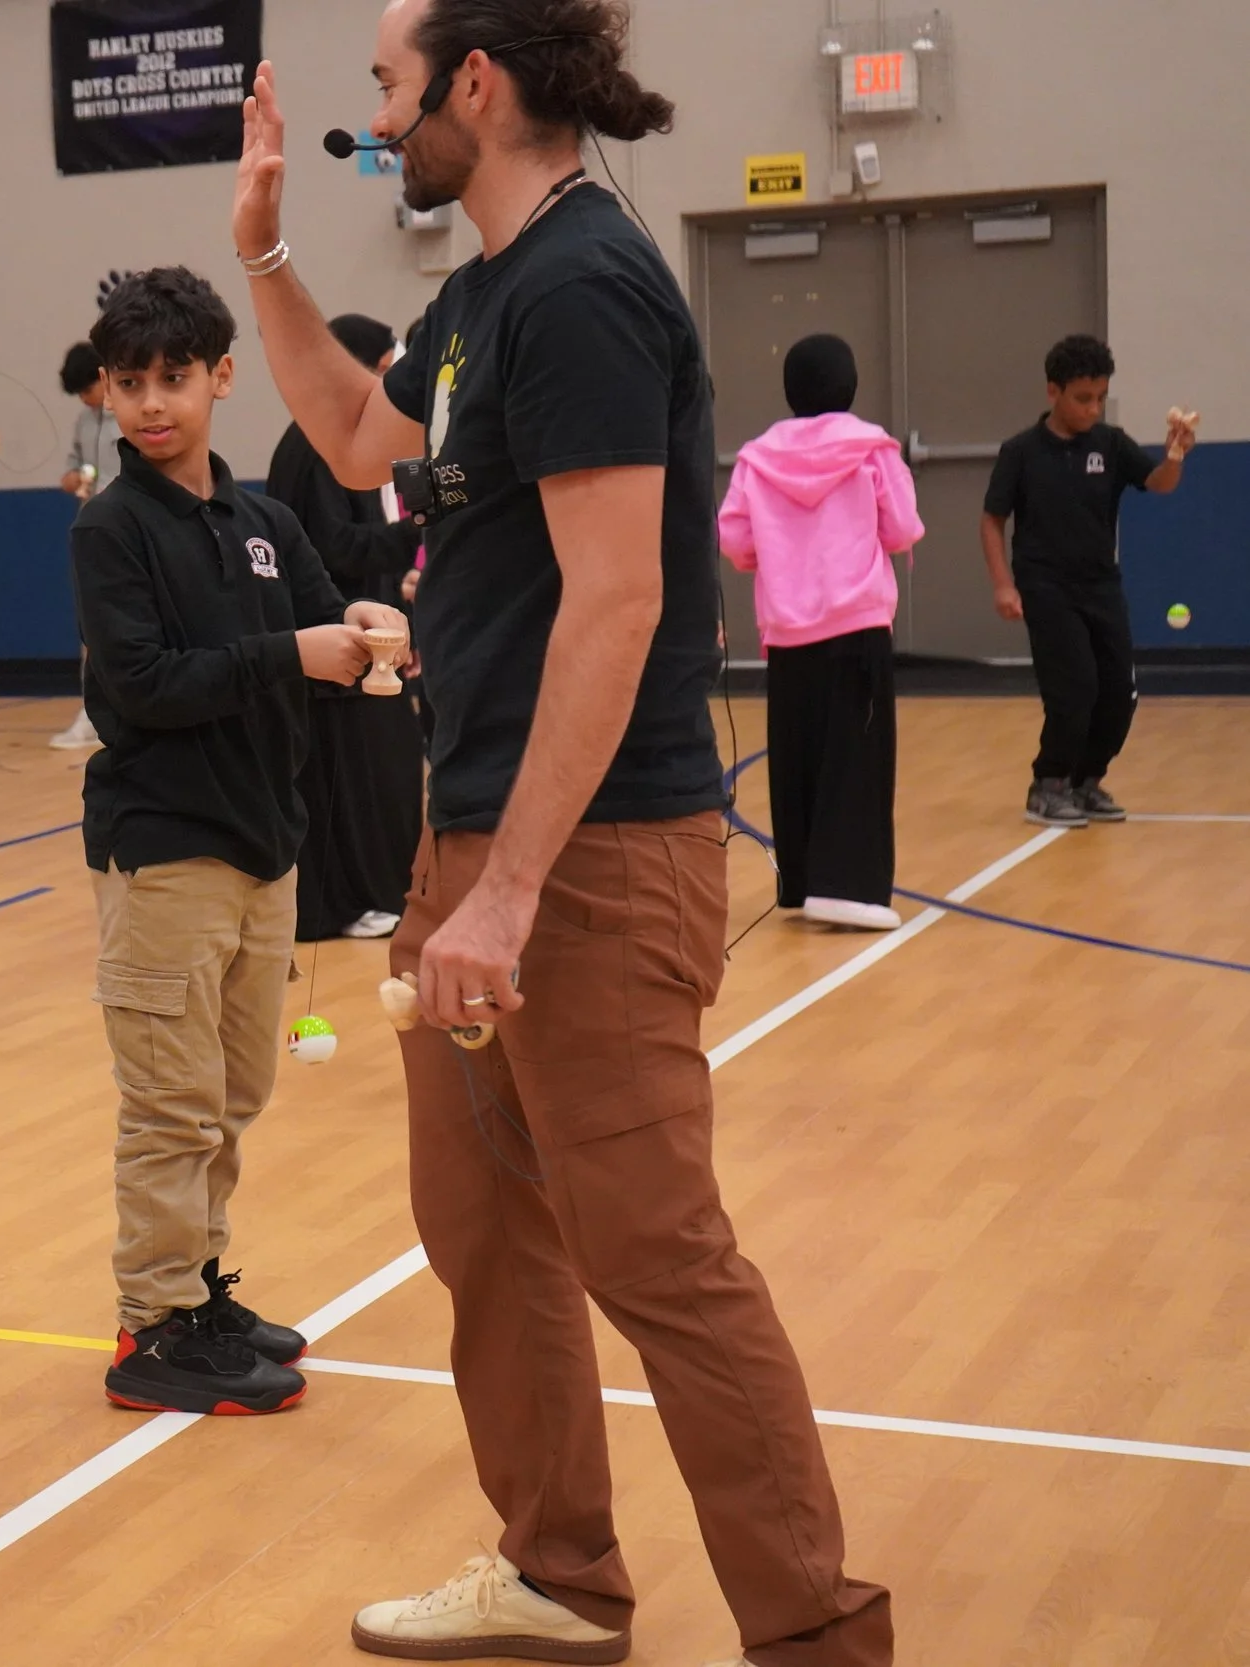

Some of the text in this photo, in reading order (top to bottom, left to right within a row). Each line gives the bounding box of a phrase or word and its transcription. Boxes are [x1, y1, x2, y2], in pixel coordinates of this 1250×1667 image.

[153, 25, 224, 51] HUSKIES
[136, 51, 176, 72] 2012
[854, 52, 904, 95] EXIT
[71, 62, 245, 99] BOYS CROSS COUNTRY
[73, 86, 245, 119] UNITED LEAGUE CHAMPIONS
